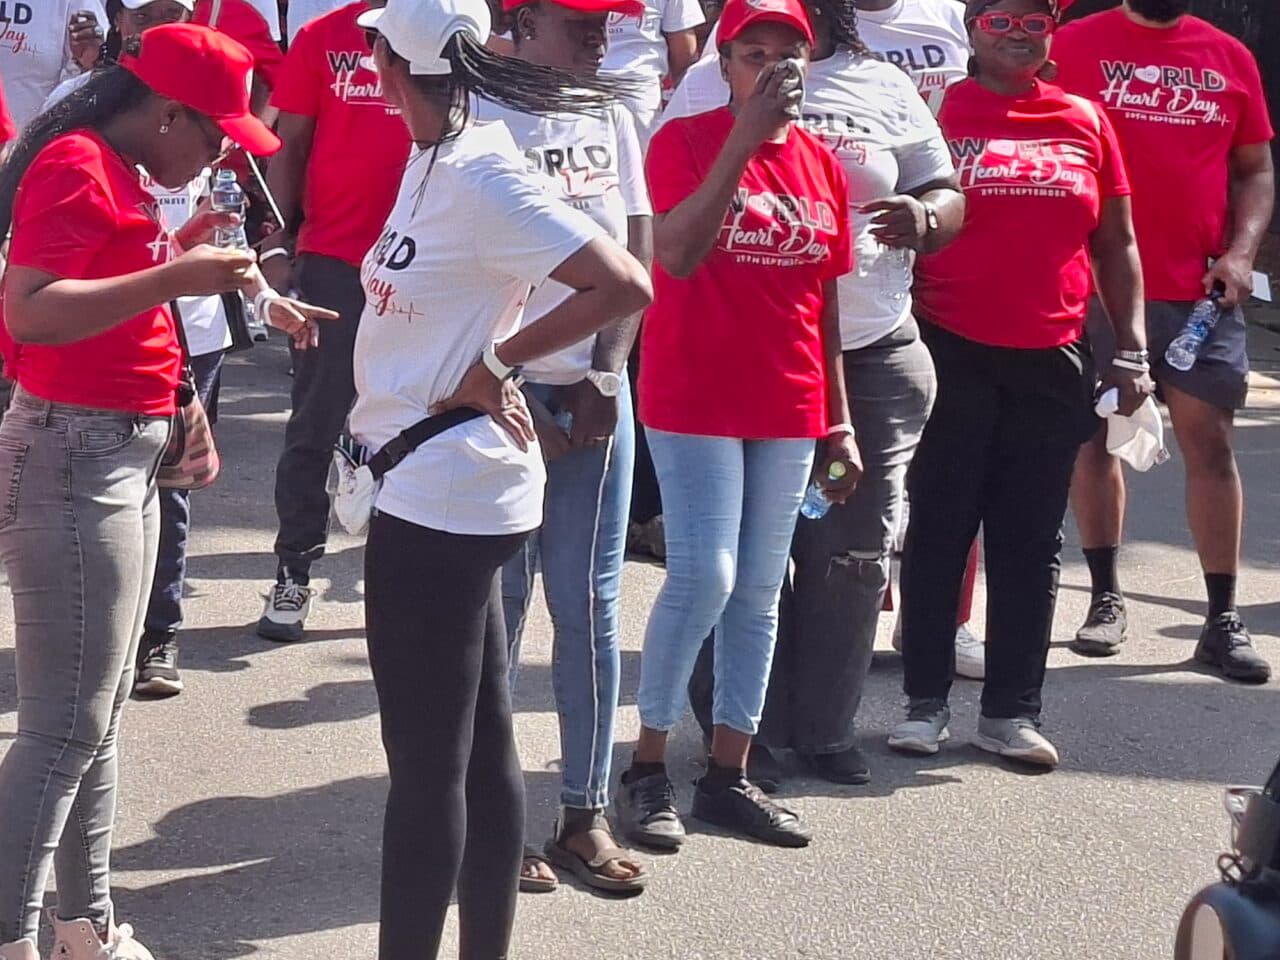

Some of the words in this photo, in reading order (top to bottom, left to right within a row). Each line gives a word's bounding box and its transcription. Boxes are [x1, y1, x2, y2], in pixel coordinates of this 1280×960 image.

[885, 44, 946, 70] RLD
[330, 70, 384, 103] Heart
[1099, 60, 1227, 93] WORLD
[1099, 80, 1166, 109] Heart
[1166, 85, 1220, 123] Day
[956, 153, 1028, 187] Heart
[1029, 156, 1087, 195] Day
[778, 221, 832, 262] Day
